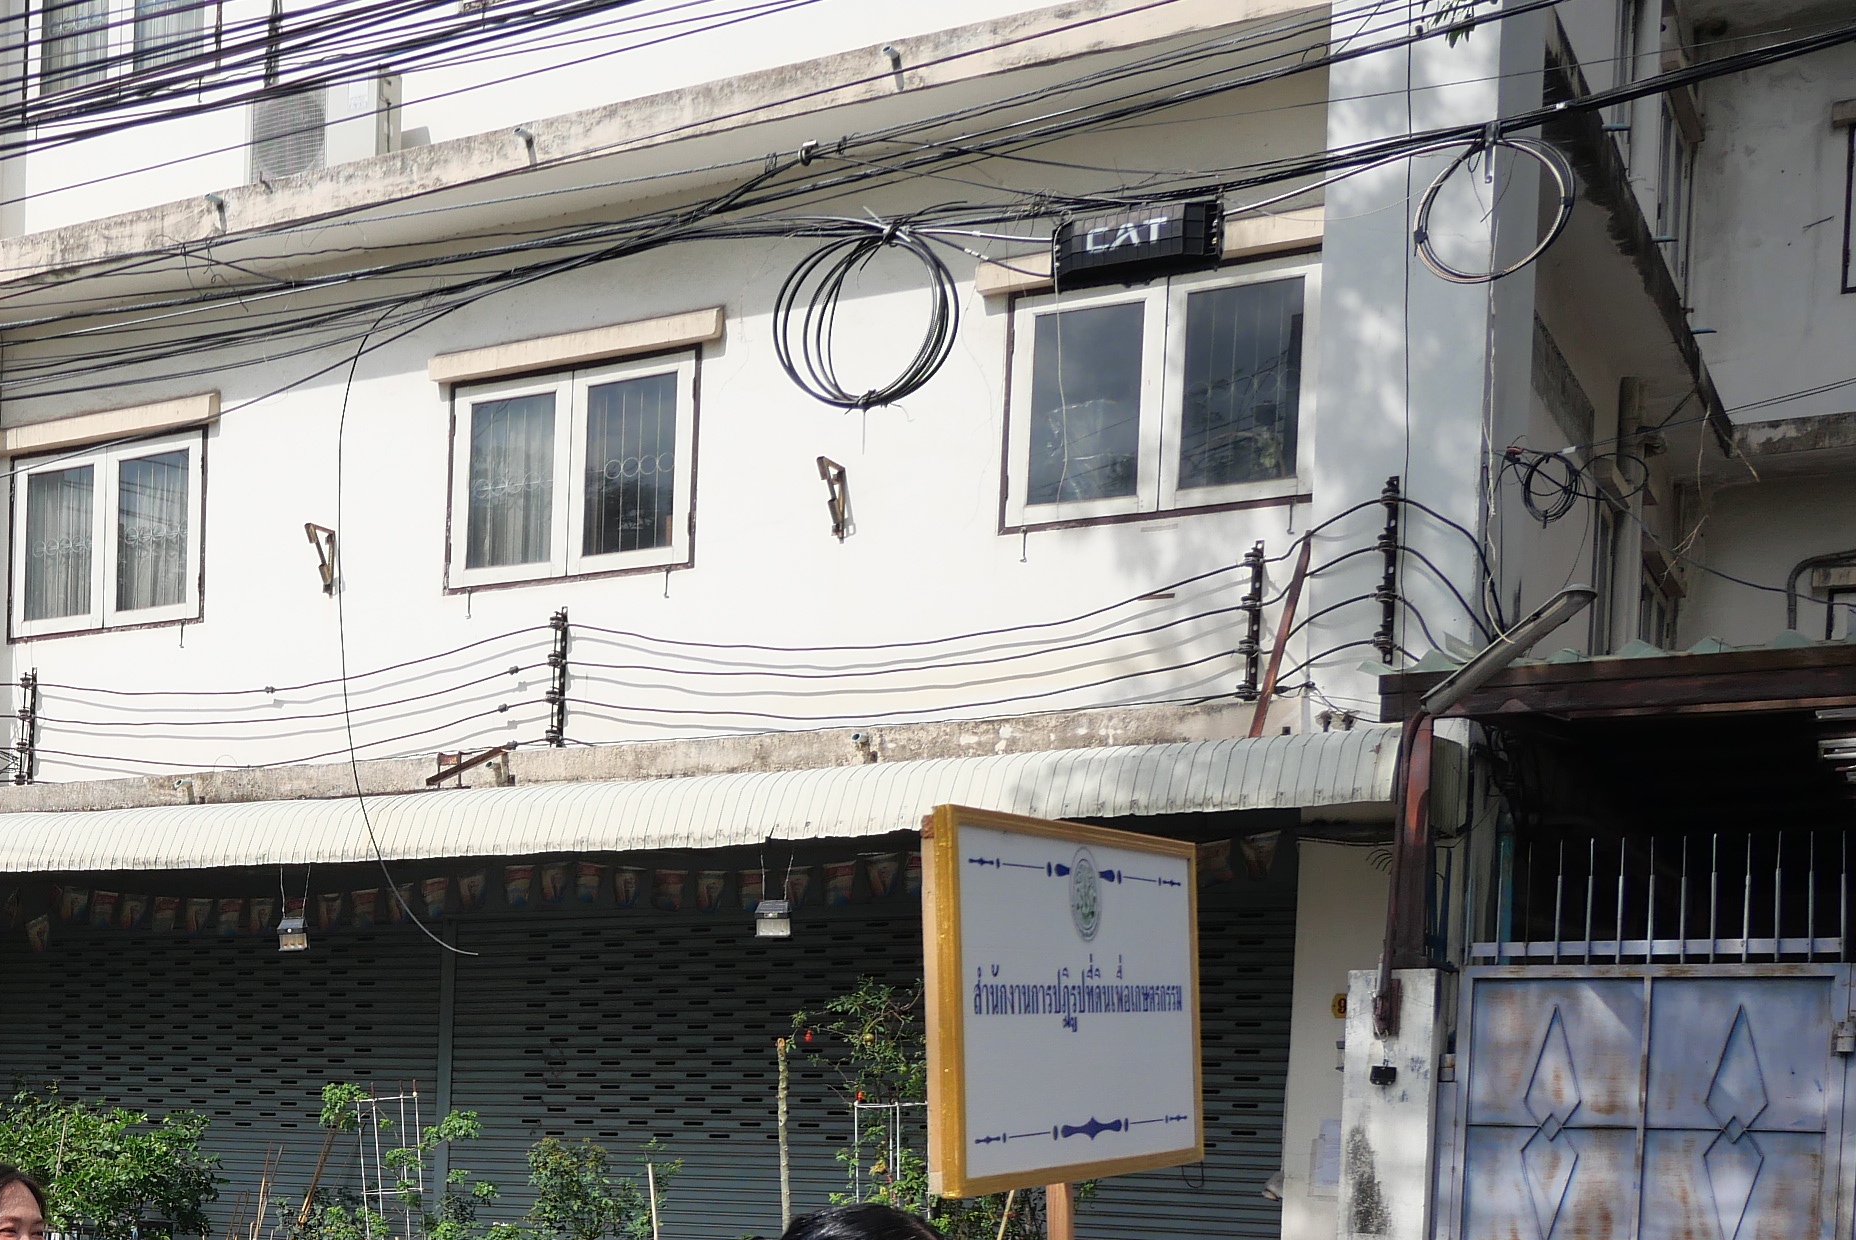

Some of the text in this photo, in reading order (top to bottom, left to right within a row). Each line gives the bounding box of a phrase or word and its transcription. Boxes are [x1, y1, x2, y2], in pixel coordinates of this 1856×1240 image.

[1085, 216, 1168, 254] CAT
[973, 953, 1183, 1033] สำนักงานการปฏิรูปที่ดินเพื่อเกษตรกรรม
